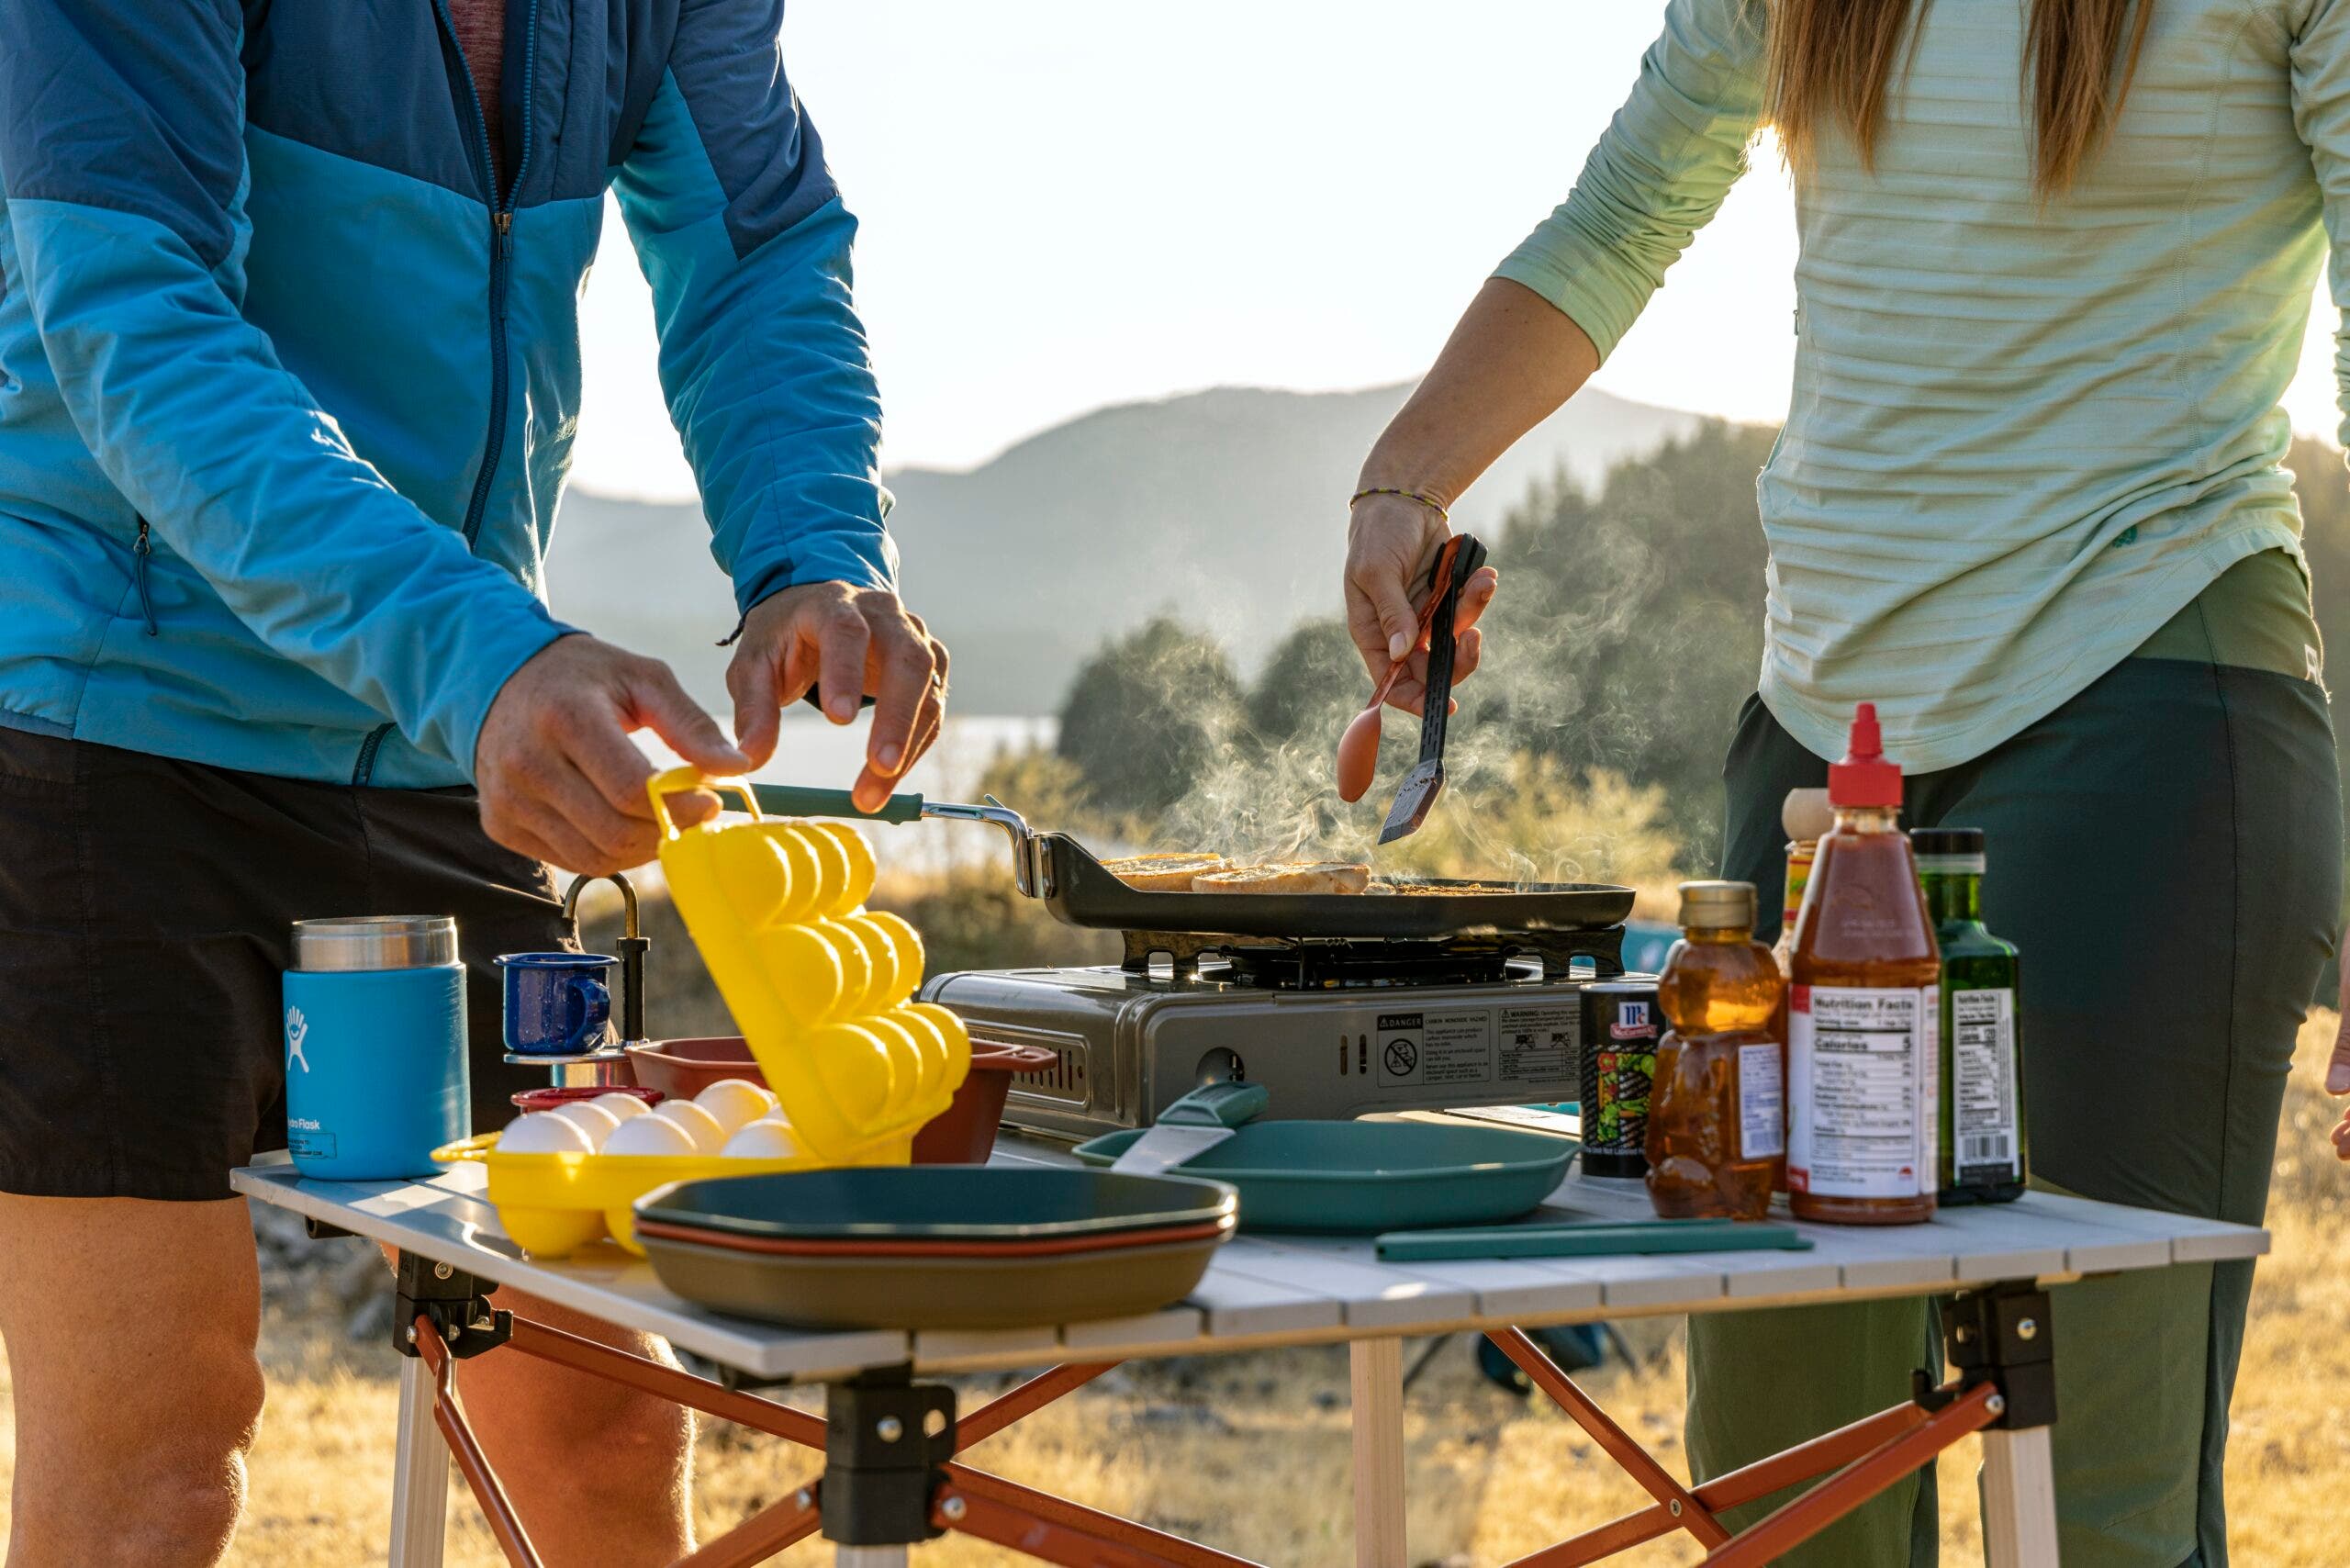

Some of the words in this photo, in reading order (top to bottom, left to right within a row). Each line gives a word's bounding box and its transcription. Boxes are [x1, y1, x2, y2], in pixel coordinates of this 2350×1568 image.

[1815, 998, 1872, 1009] Nutrition
[1877, 998, 1913, 1009] Facts
[1389, 1018, 1422, 1027] DANGER
[1815, 1037, 1868, 1049] Calories
[298, 1118, 320, 1130] Flask
